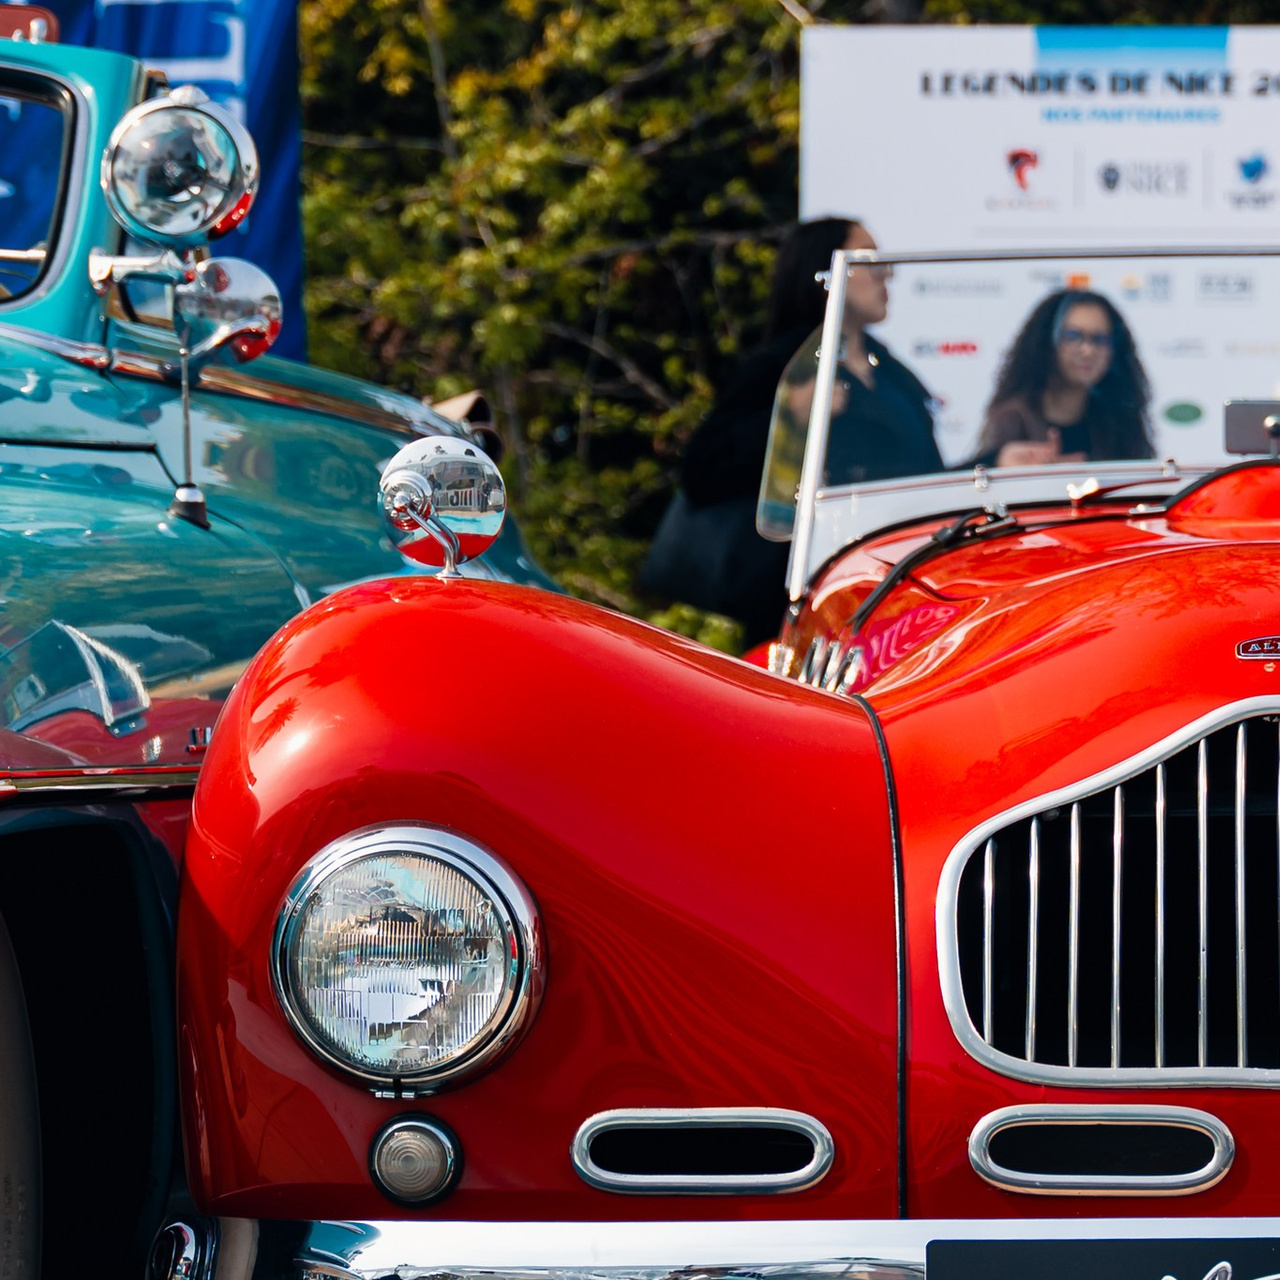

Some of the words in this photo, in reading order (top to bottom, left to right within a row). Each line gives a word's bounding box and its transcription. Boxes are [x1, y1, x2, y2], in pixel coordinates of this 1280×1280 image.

[919, 71, 1098, 97] LEGENDES
[1108, 71, 1151, 97] DE
[1165, 71, 1236, 97] NICE
